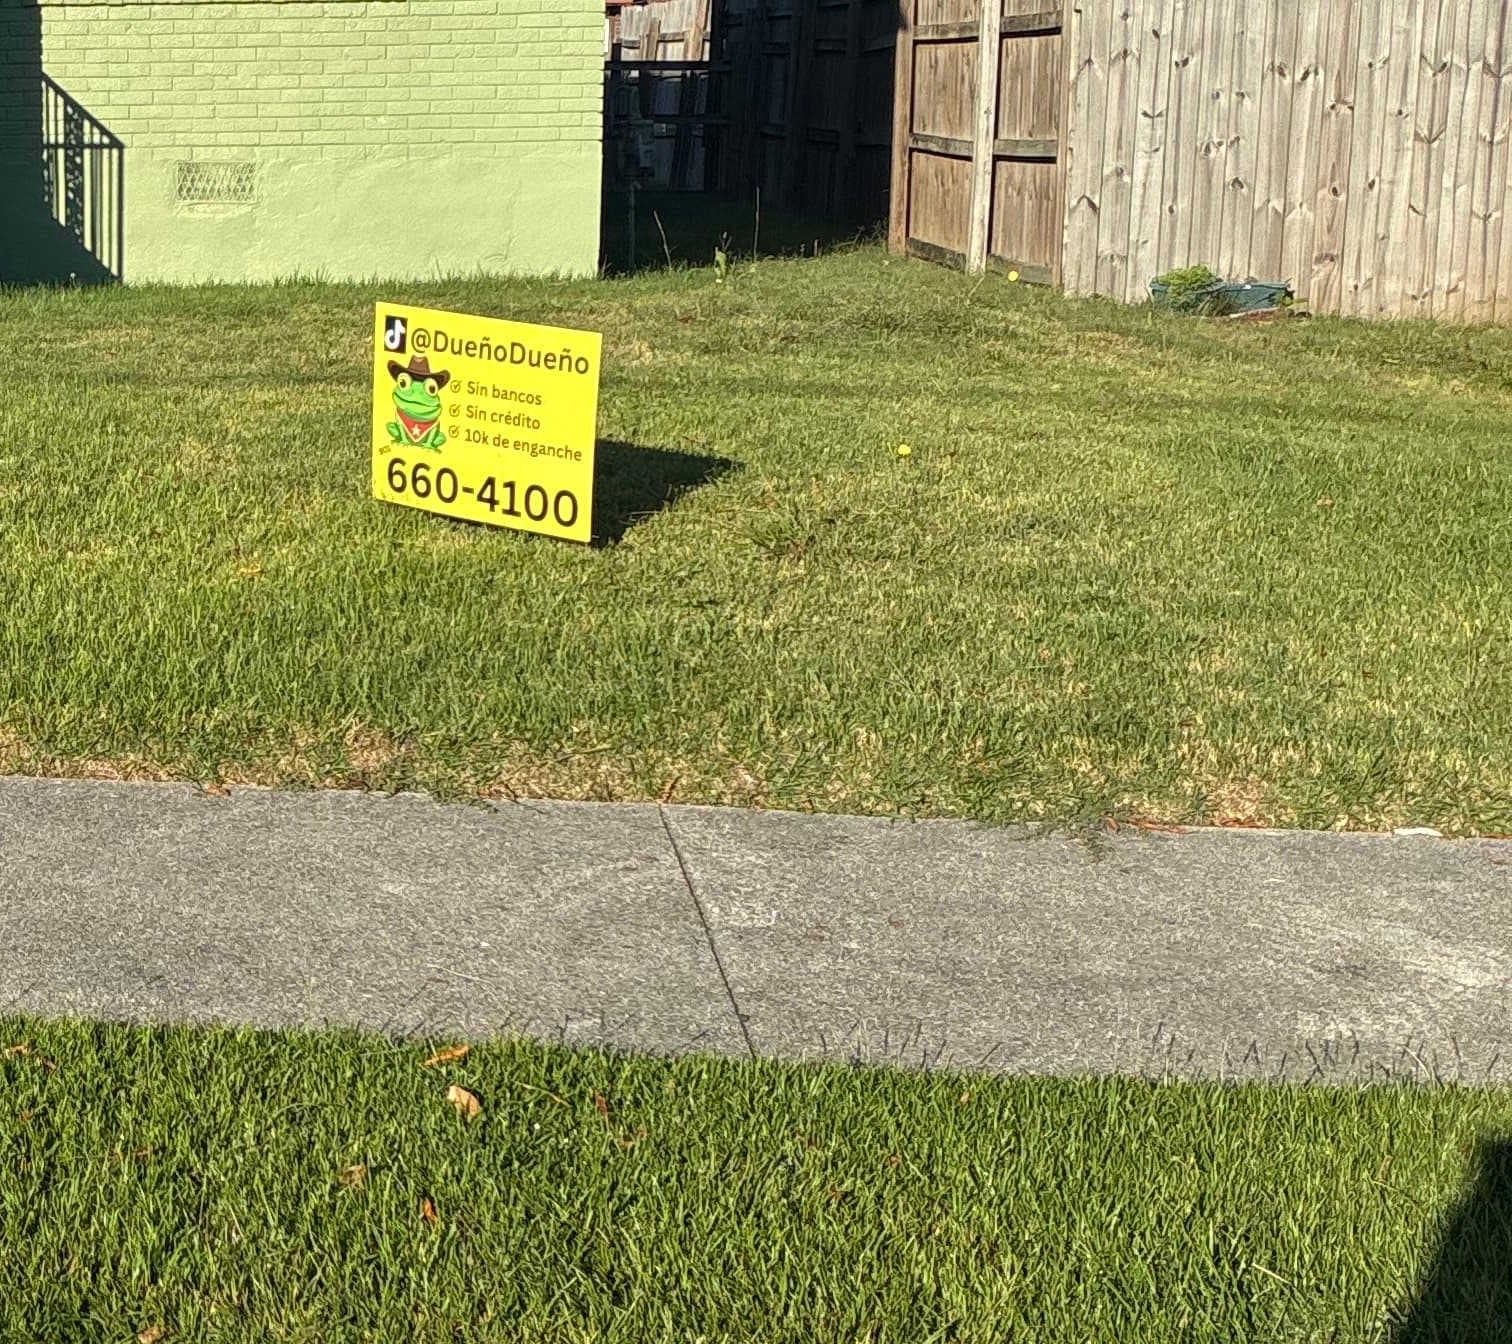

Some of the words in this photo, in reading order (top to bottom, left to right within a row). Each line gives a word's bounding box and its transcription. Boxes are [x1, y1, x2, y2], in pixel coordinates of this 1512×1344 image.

[411, 328, 589, 375] @DueñoDueño
[467, 380, 488, 397] Sin
[493, 384, 542, 405] bancos
[466, 404, 486, 421] Sin
[490, 409, 541, 430] crédito
[465, 428, 489, 445] 10k
[493, 434, 509, 449] de
[513, 438, 583, 461] enganche
[387, 458, 579, 528] 660-4100
